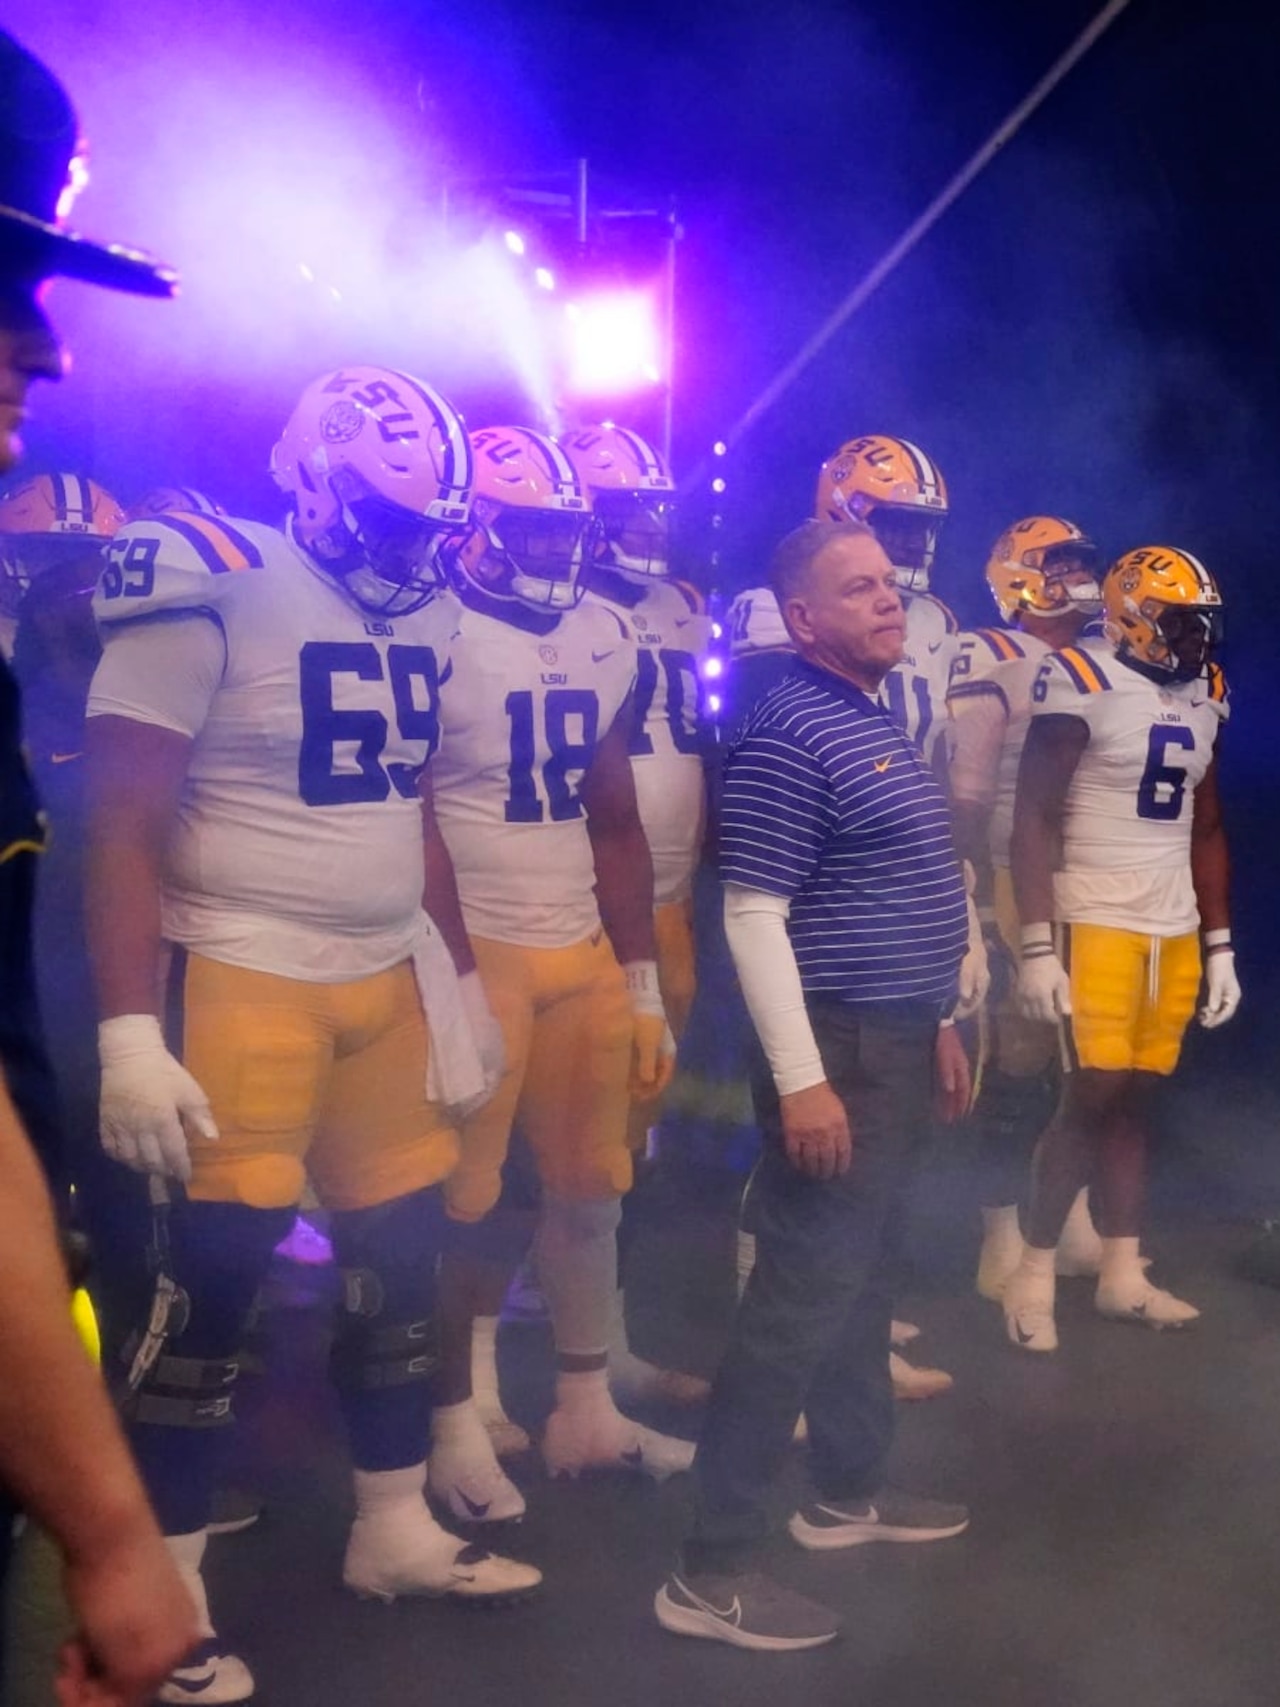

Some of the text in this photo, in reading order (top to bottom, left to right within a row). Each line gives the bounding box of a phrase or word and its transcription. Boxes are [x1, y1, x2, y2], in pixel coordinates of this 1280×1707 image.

[102, 538, 161, 600] 69
[363, 623, 395, 637] LSU
[540, 672, 568, 685] LSU
[1033, 665, 1053, 702] 6
[298, 640, 443, 808] 69
[504, 689, 600, 824] 18
[1136, 723, 1196, 821] 6
